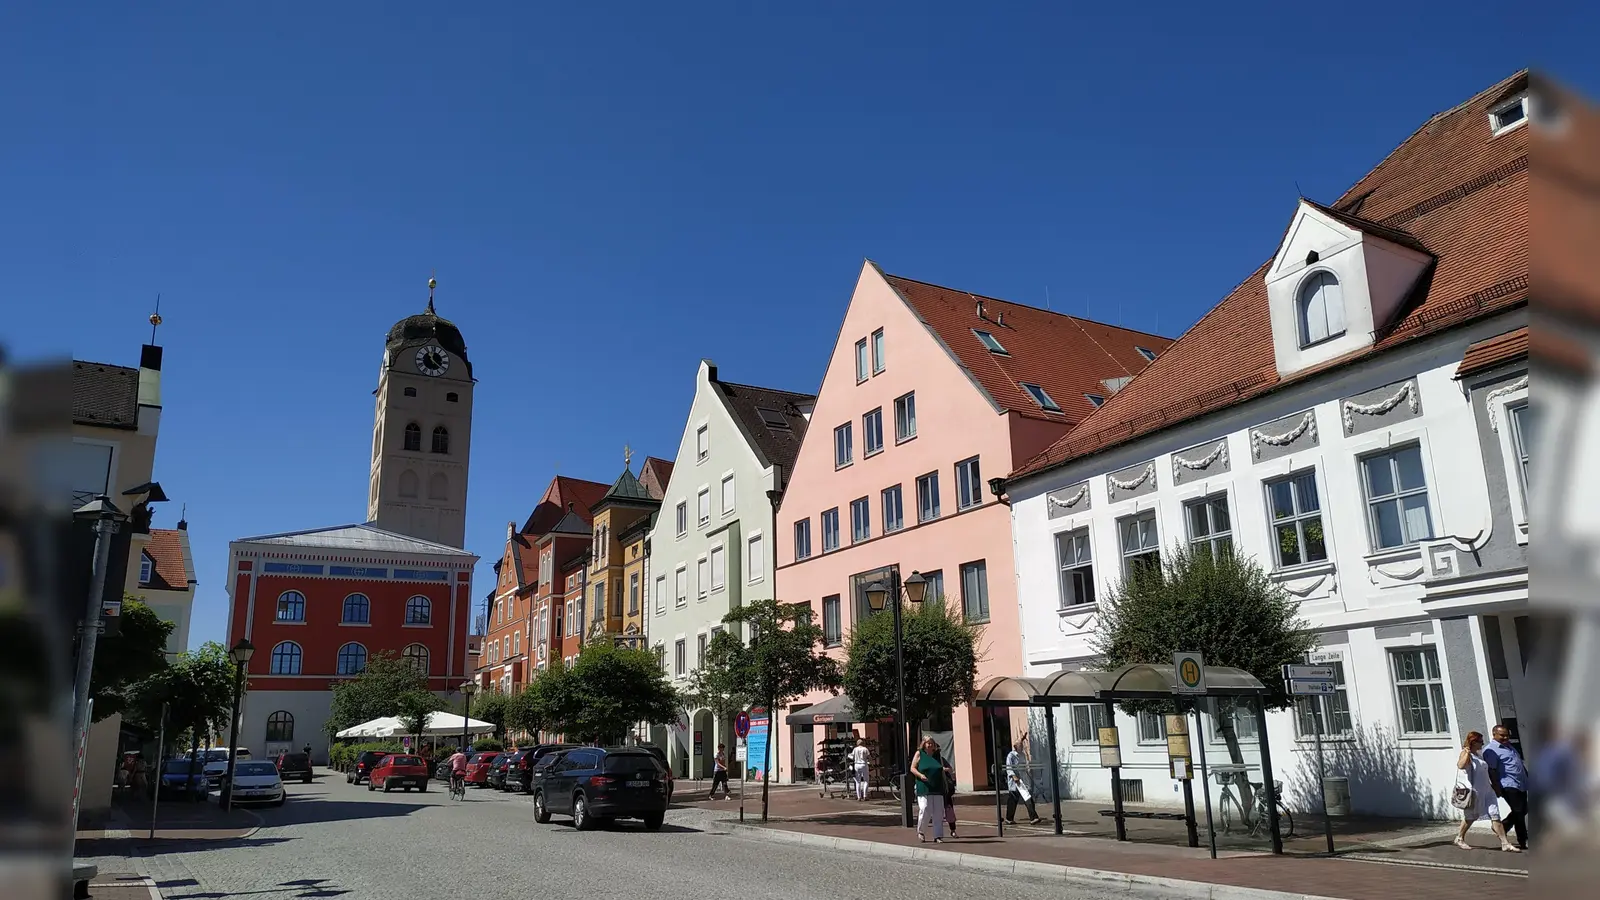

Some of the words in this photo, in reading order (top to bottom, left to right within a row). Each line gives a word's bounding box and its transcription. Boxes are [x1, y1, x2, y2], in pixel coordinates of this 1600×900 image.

[1311, 654, 1326, 662] Lange
[1328, 652, 1340, 660] Zeile
[1185, 663, 1196, 681] H
